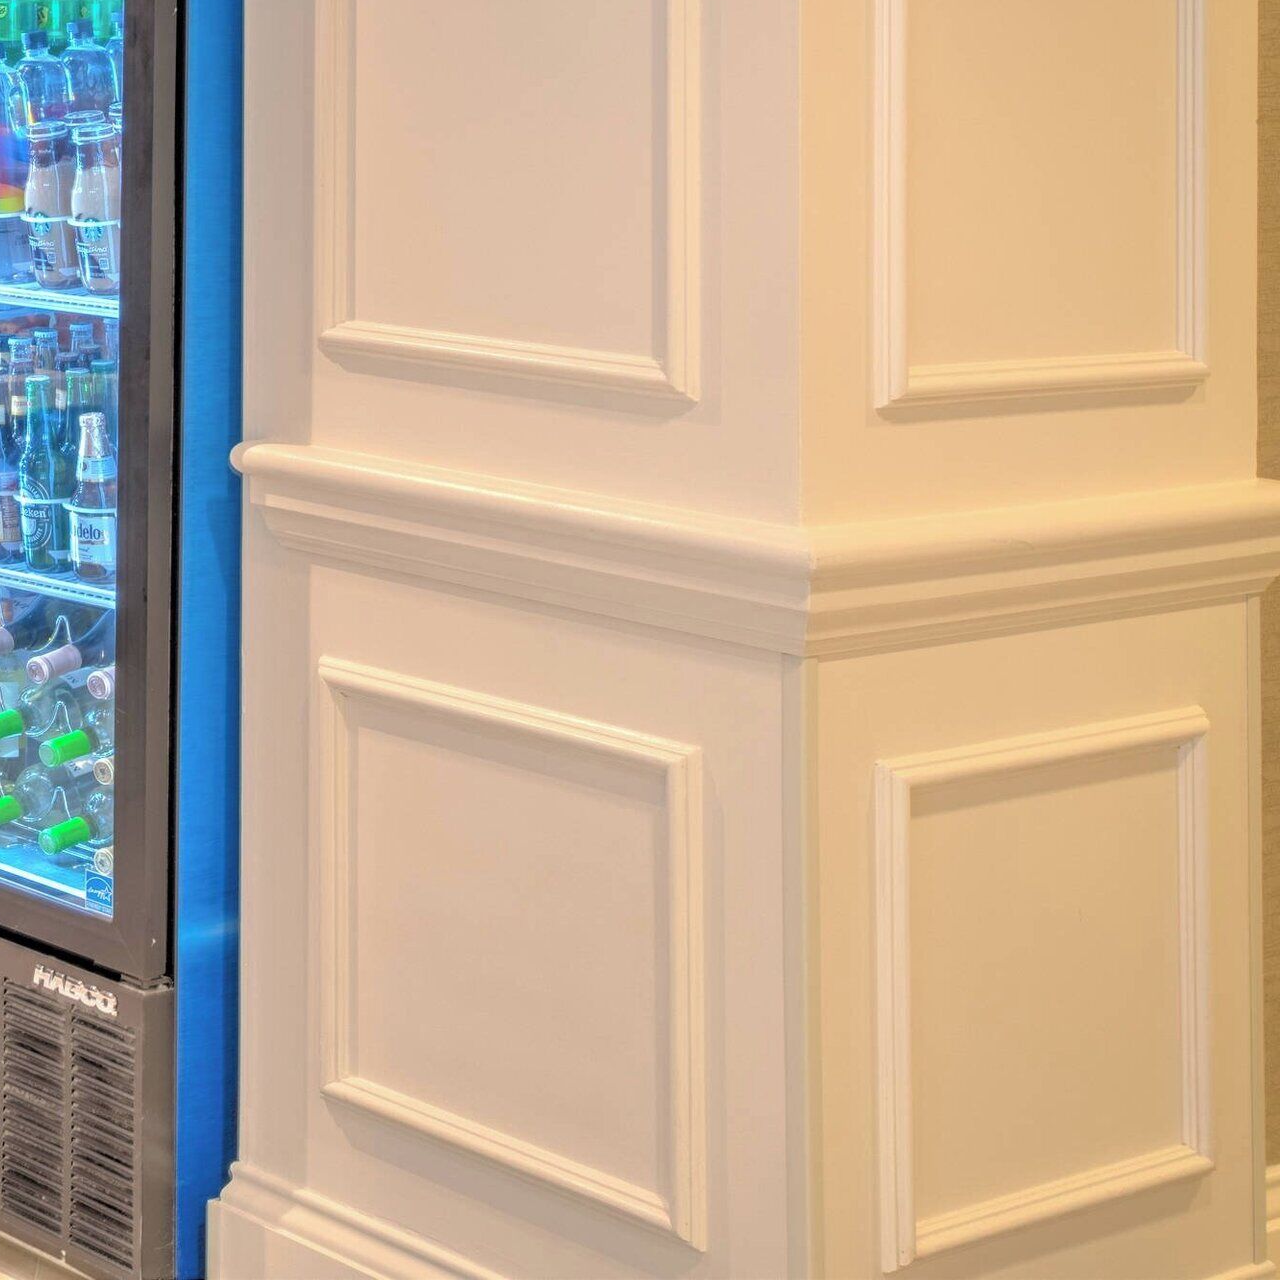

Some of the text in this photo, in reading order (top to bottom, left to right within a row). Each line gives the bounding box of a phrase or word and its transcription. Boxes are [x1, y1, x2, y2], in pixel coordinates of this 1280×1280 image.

[24, 508, 46, 518] eken
[77, 524, 101, 540] delo
[33, 966, 117, 1015] HABCO
